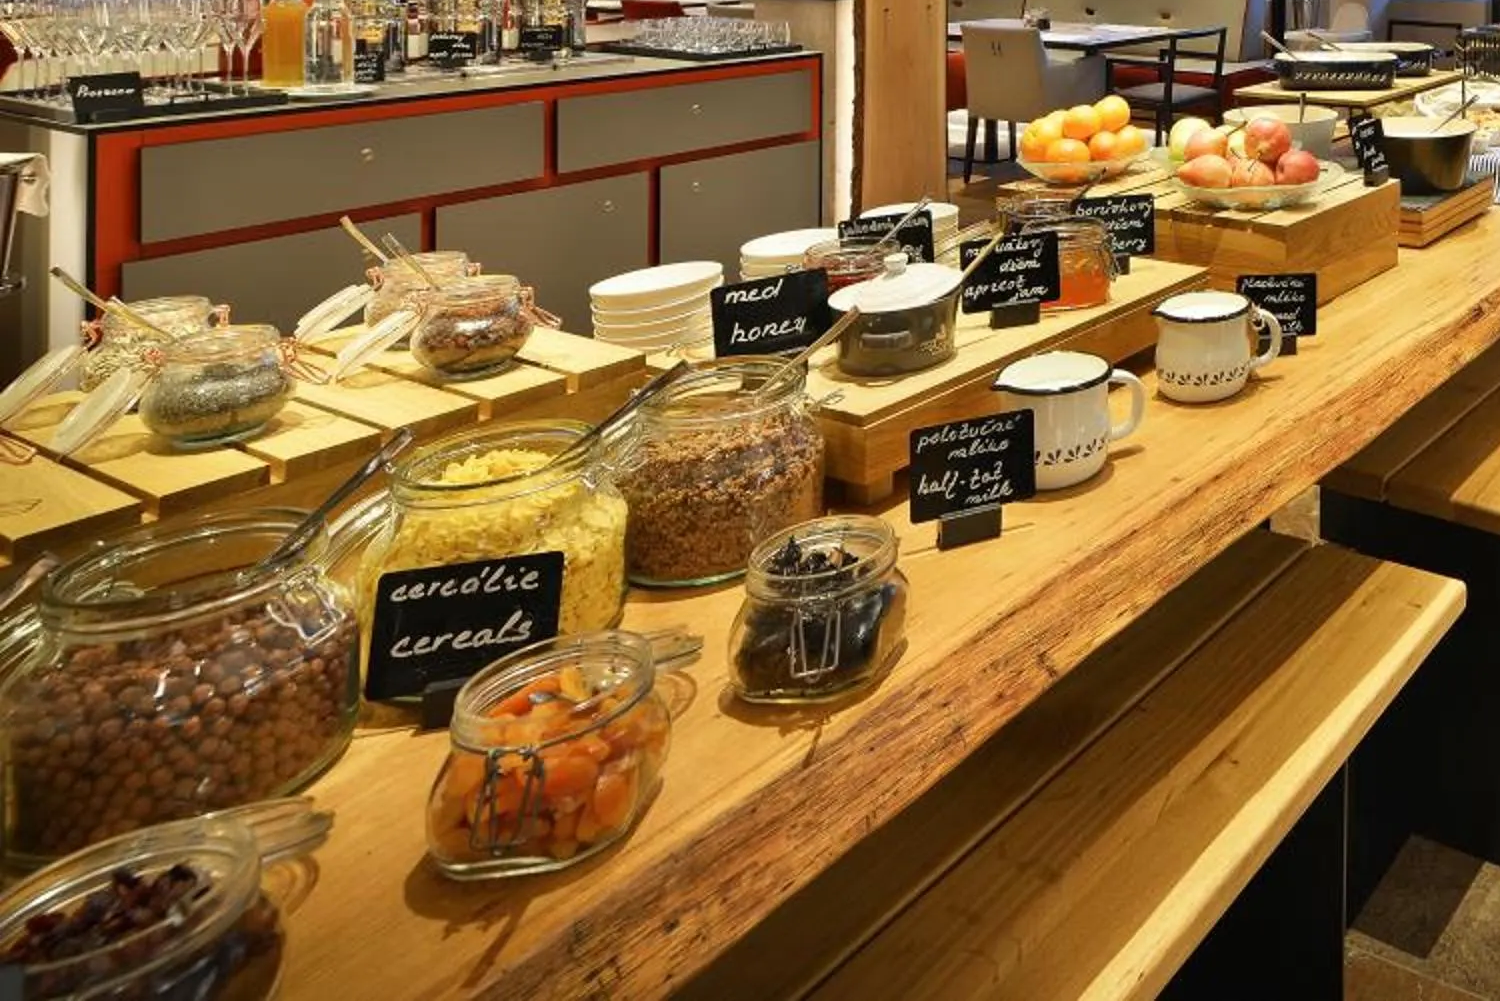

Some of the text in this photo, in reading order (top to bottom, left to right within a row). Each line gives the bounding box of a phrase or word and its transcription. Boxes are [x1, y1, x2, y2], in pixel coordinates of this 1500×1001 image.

[724, 278, 784, 304] med
[729, 316, 807, 345] honey
[389, 565, 540, 603] cereálie
[389, 609, 533, 658] cereals
